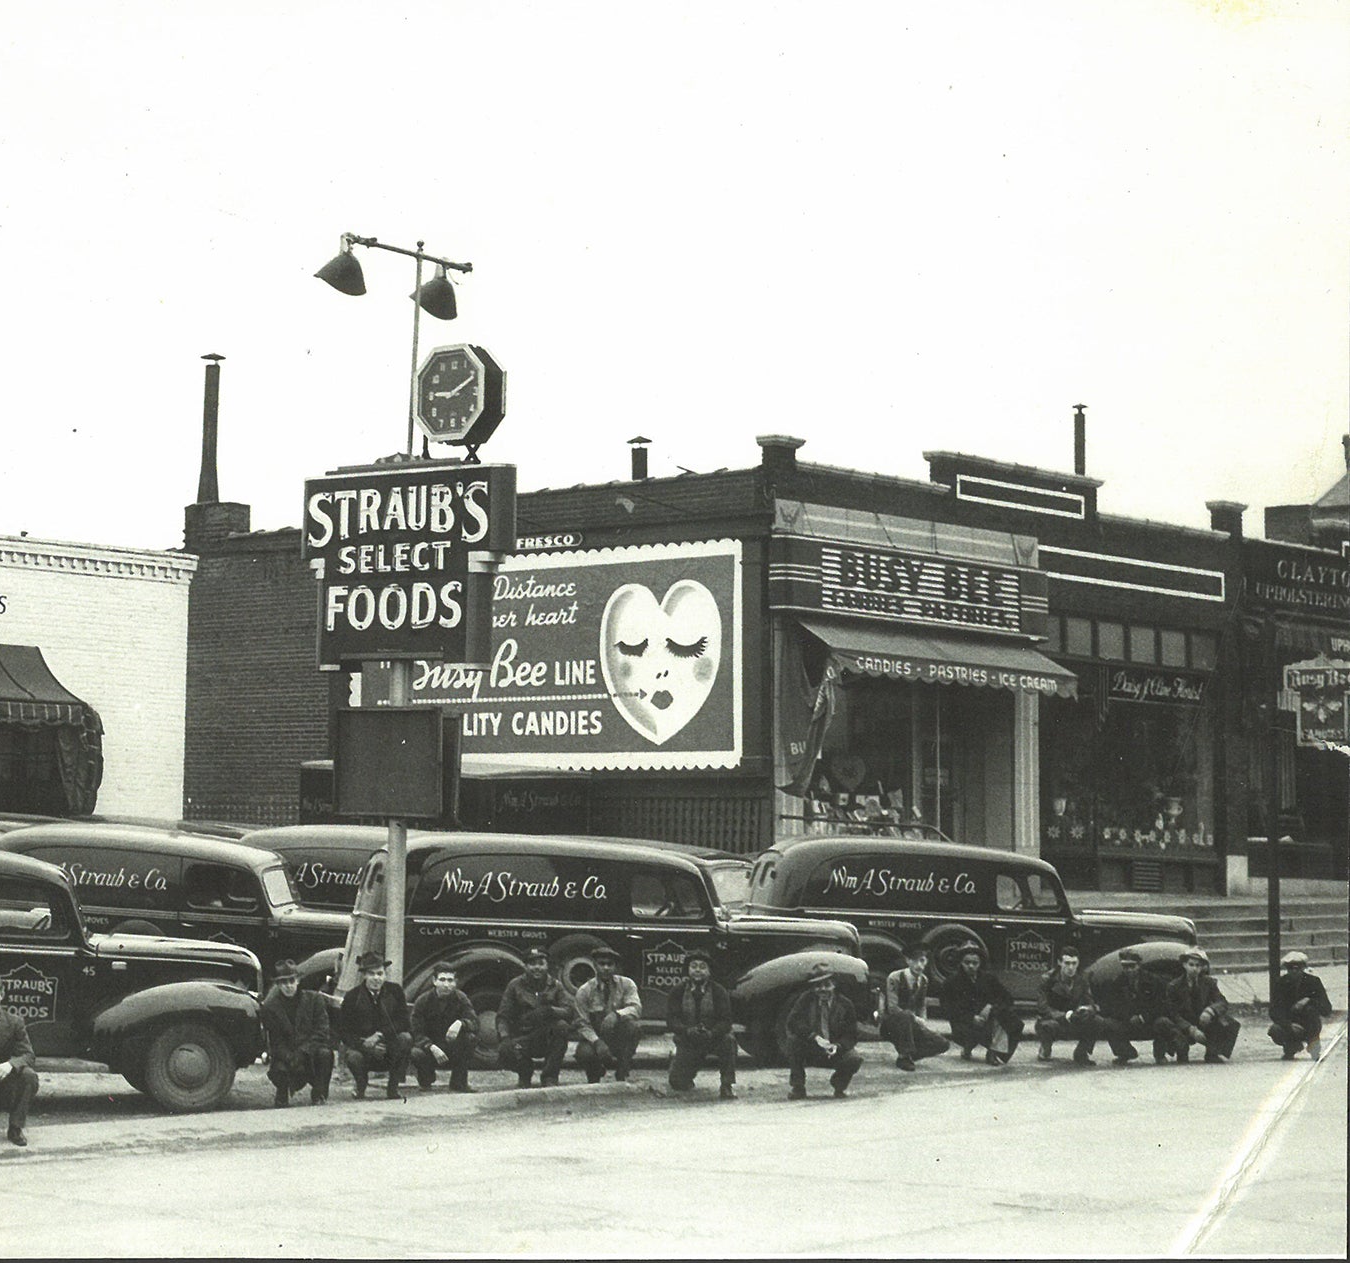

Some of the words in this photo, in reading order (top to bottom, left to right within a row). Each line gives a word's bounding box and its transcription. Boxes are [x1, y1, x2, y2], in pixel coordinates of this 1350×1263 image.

[307, 480, 489, 548] STRAUB'S
[516, 534, 574, 549] FRESCO
[337, 540, 451, 575] SELECT
[493, 575, 577, 601] Distance
[840, 550, 924, 592] BUSY
[944, 565, 1004, 604] BEE
[327, 580, 463, 632] FOODS
[492, 606, 519, 628] er
[525, 601, 579, 627] heart
[490, 639, 548, 688] Bee
[554, 659, 597, 686] LINE
[462, 712, 502, 736] LITY
[511, 710, 603, 736] CANDIES
[70, 863, 125, 888] Straub
[128, 873, 140, 889] &
[144, 868, 167, 891] Co.
[433, 867, 474, 900] Wm
[467, 871, 493, 902] A
[490, 871, 560, 903] Straub
[564, 882, 578, 899] &
[822, 866, 858, 894] Wm
[852, 868, 875, 895] A
[872, 869, 935, 896] Straub
[938, 878, 950, 893] &
[419, 927, 469, 936] CLAYTON
[488, 929, 518, 938] WEBSTER
[82, 965, 96, 977] 45
[656, 966, 683, 974] SELECT
[1, 979, 54, 995] TRAUB'S
[8, 994, 41, 1005] SELECT
